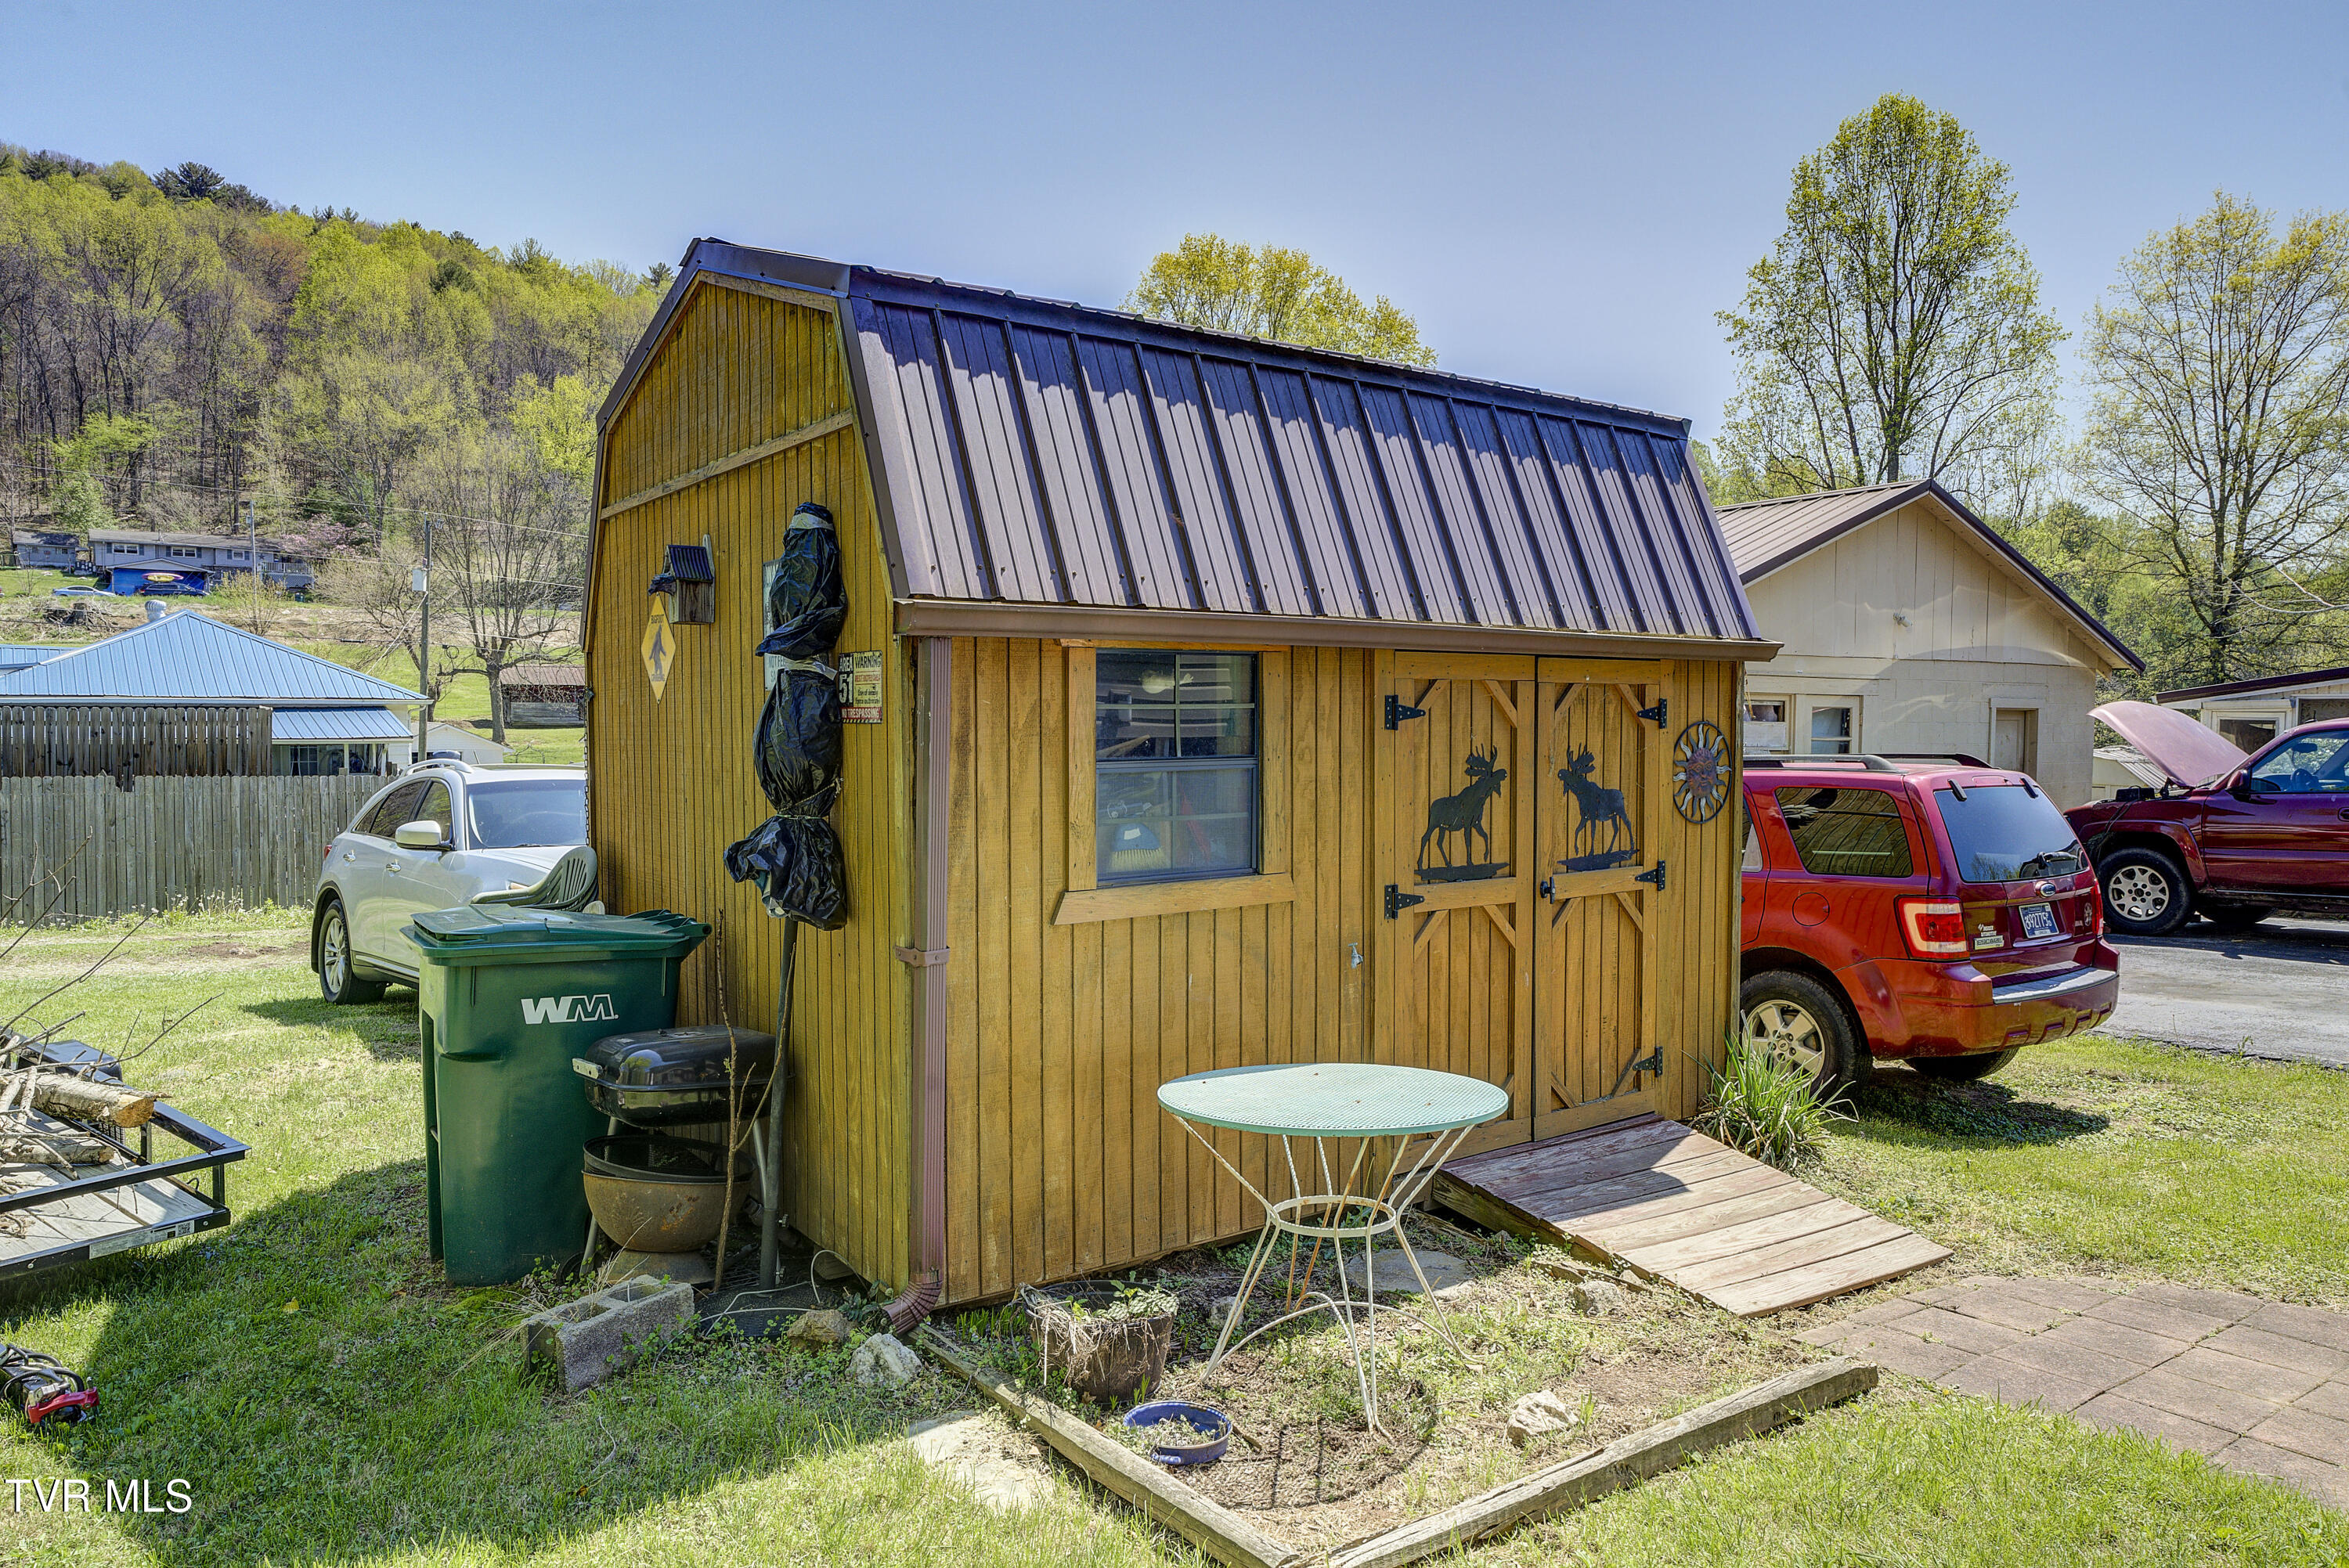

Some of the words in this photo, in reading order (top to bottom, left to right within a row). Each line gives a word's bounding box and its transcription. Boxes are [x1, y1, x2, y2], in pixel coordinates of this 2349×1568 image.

[768, 655, 778, 668] NOT
[839, 657, 853, 672] AREA
[855, 655, 881, 669] WARNING
[839, 673, 853, 703] 51
[842, 708, 847, 719] NO
[847, 708, 879, 719] TRESPASSING
[521, 993, 615, 1025] WM
